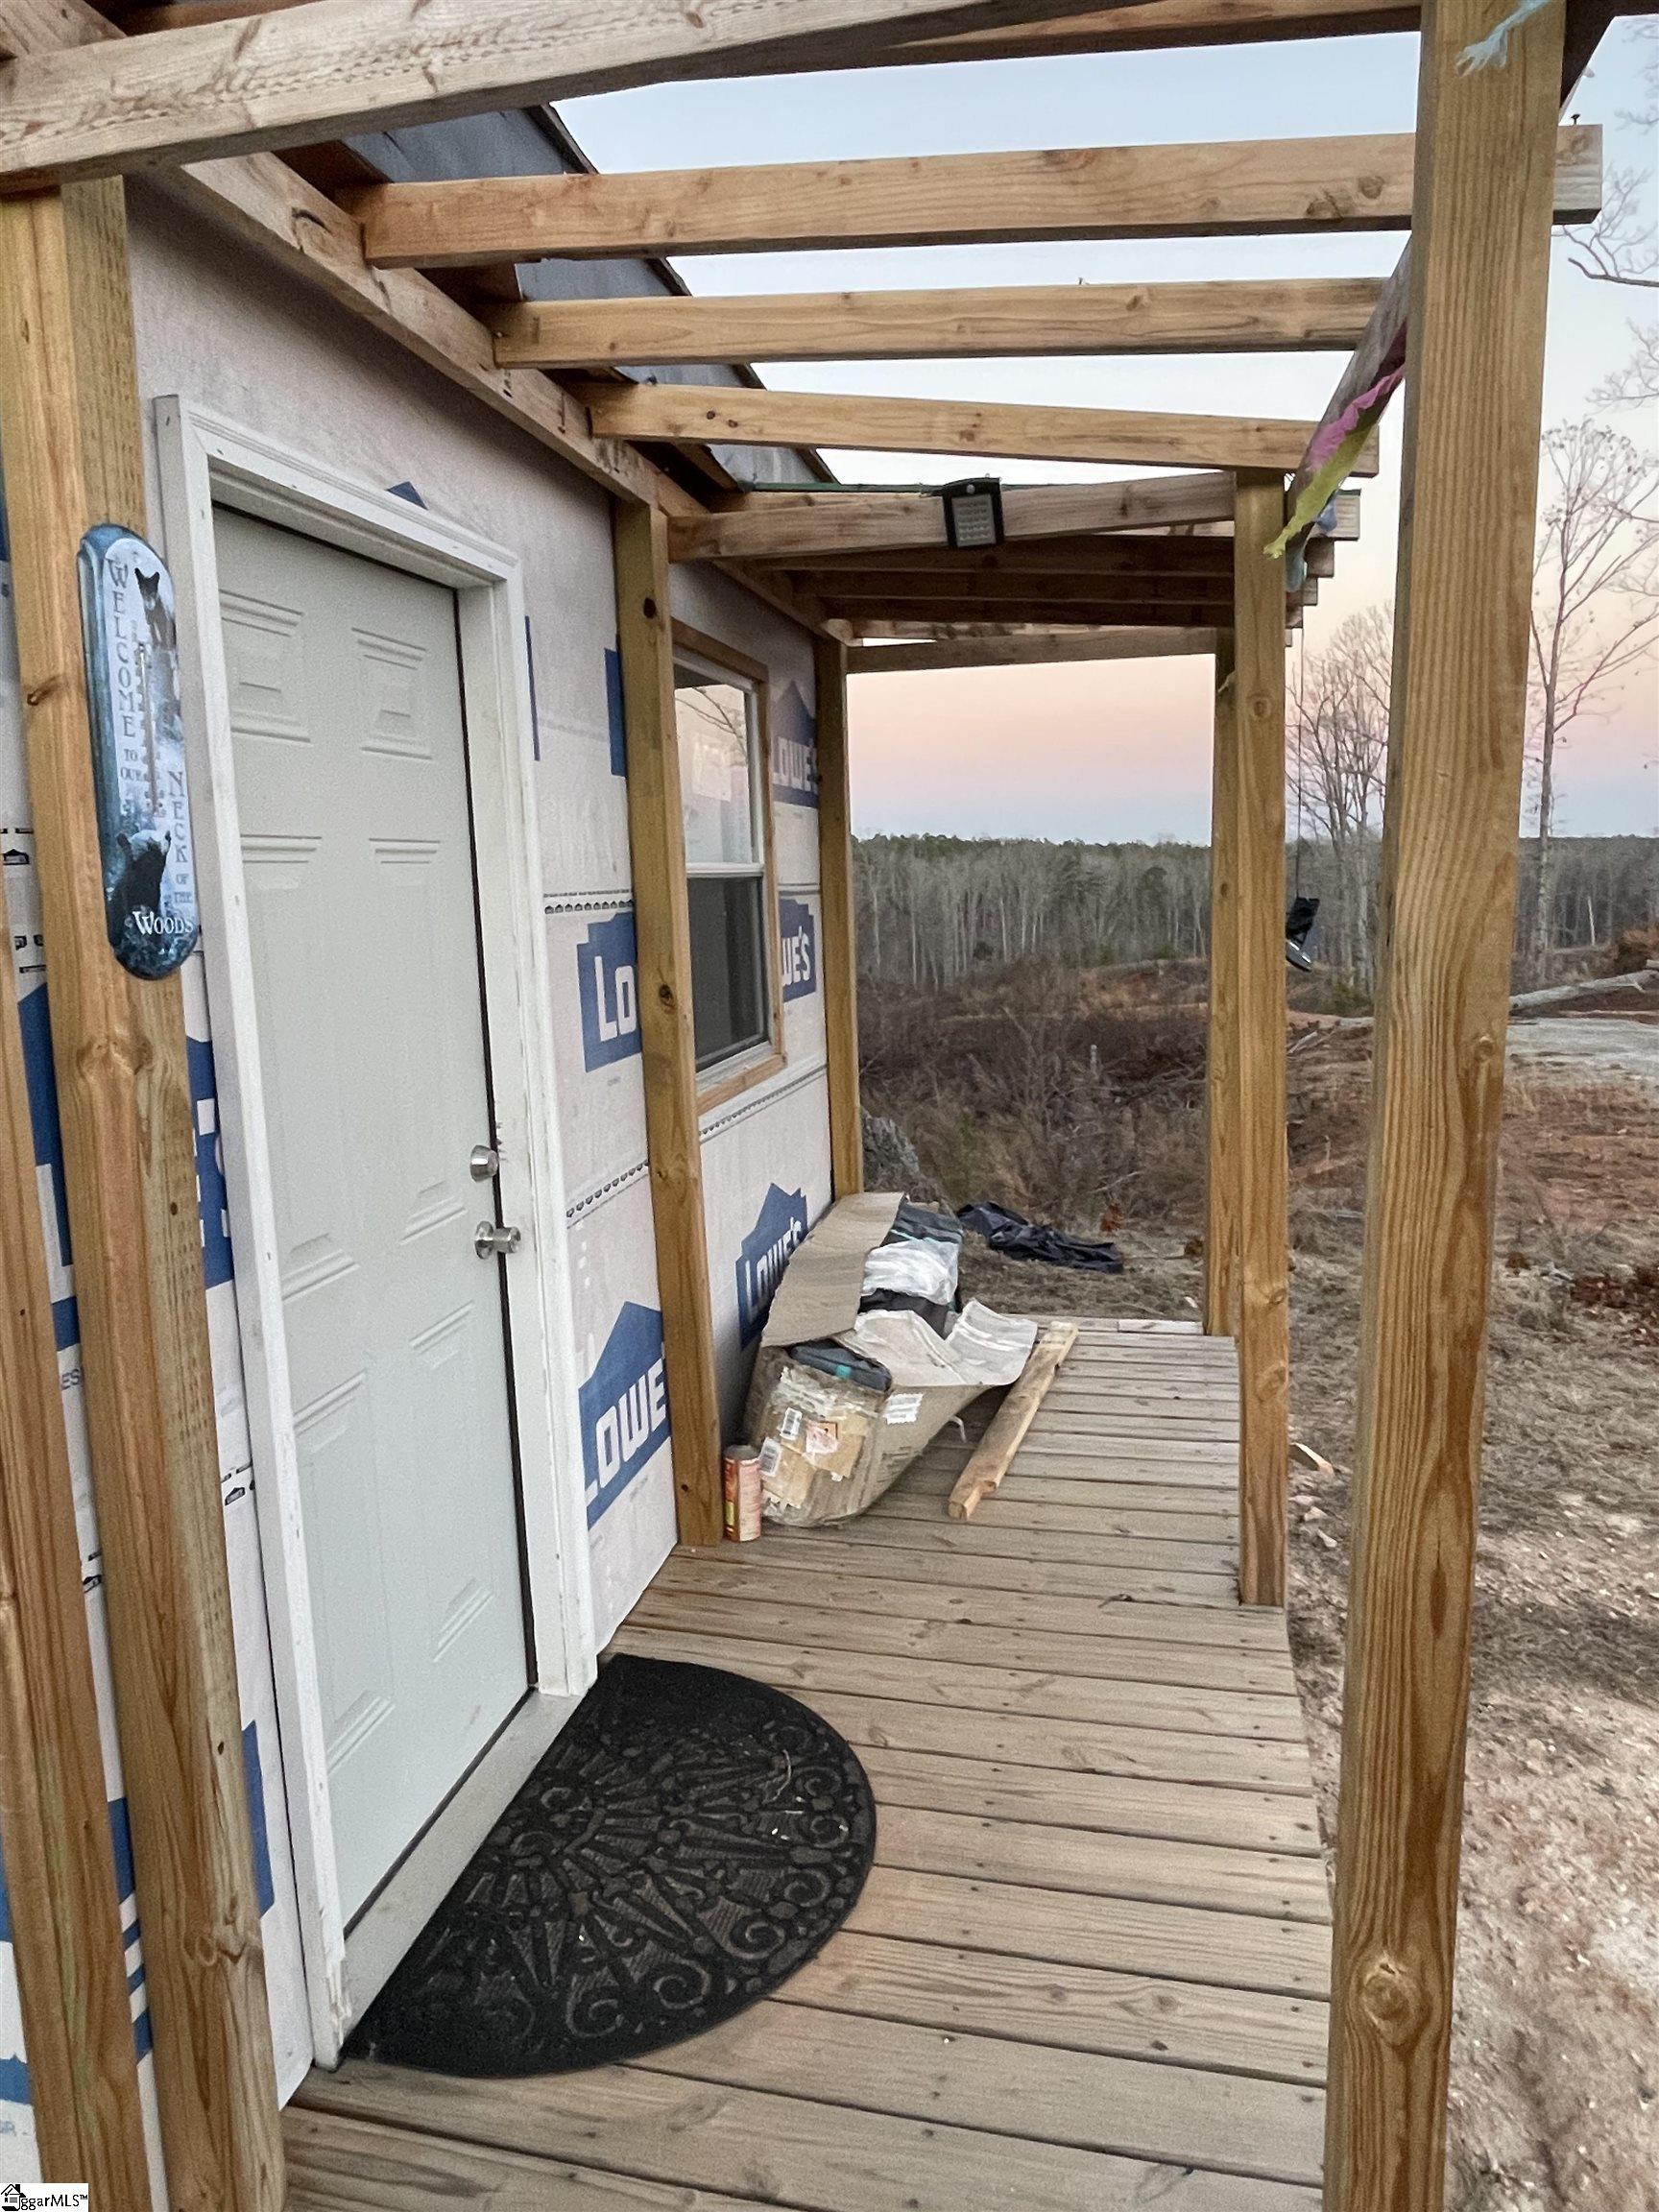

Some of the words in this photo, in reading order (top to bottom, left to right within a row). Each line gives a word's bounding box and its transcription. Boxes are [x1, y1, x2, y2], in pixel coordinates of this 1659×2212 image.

[105, 558, 136, 738] WELCOME
[124, 748, 138, 762] TO
[120, 766, 142, 782] OUR
[167, 770, 188, 864] NECK
[132, 910, 194, 936] WOODS
